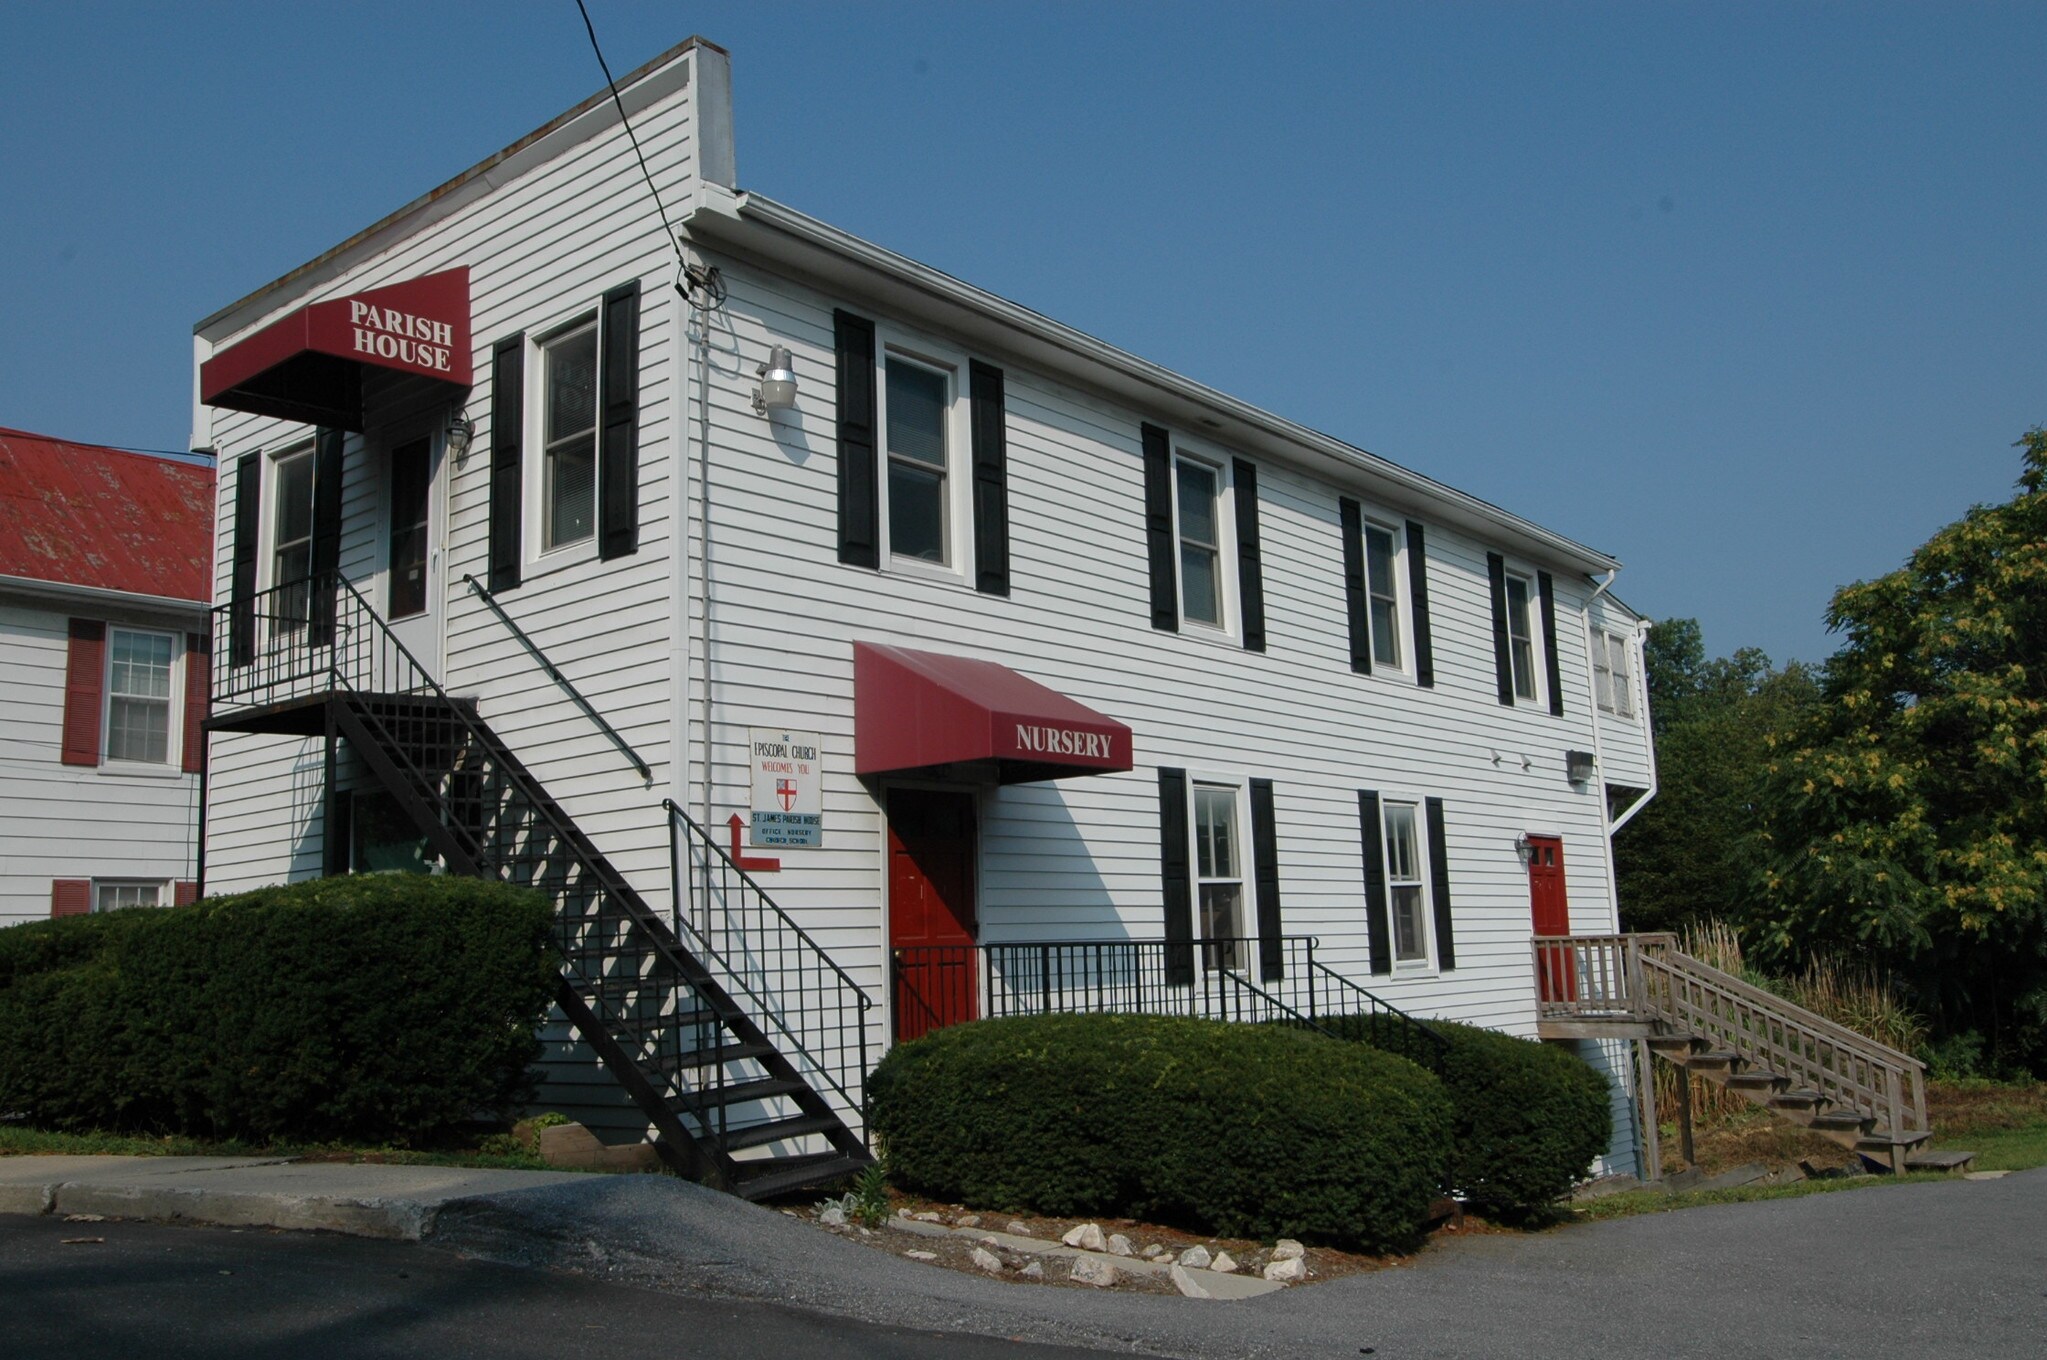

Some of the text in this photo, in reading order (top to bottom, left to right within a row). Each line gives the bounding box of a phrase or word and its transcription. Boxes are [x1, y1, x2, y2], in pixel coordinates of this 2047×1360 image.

[349, 300, 453, 347] PARISH
[353, 328, 451, 372] HOUSE
[754, 742, 816, 760] EPISCOPAL CHURCH
[1016, 724, 1112, 759] NURSERY
[761, 761, 809, 775] WELCOMES YOU
[762, 814, 781, 823] JAMES
[782, 815, 801, 825] PARISH
